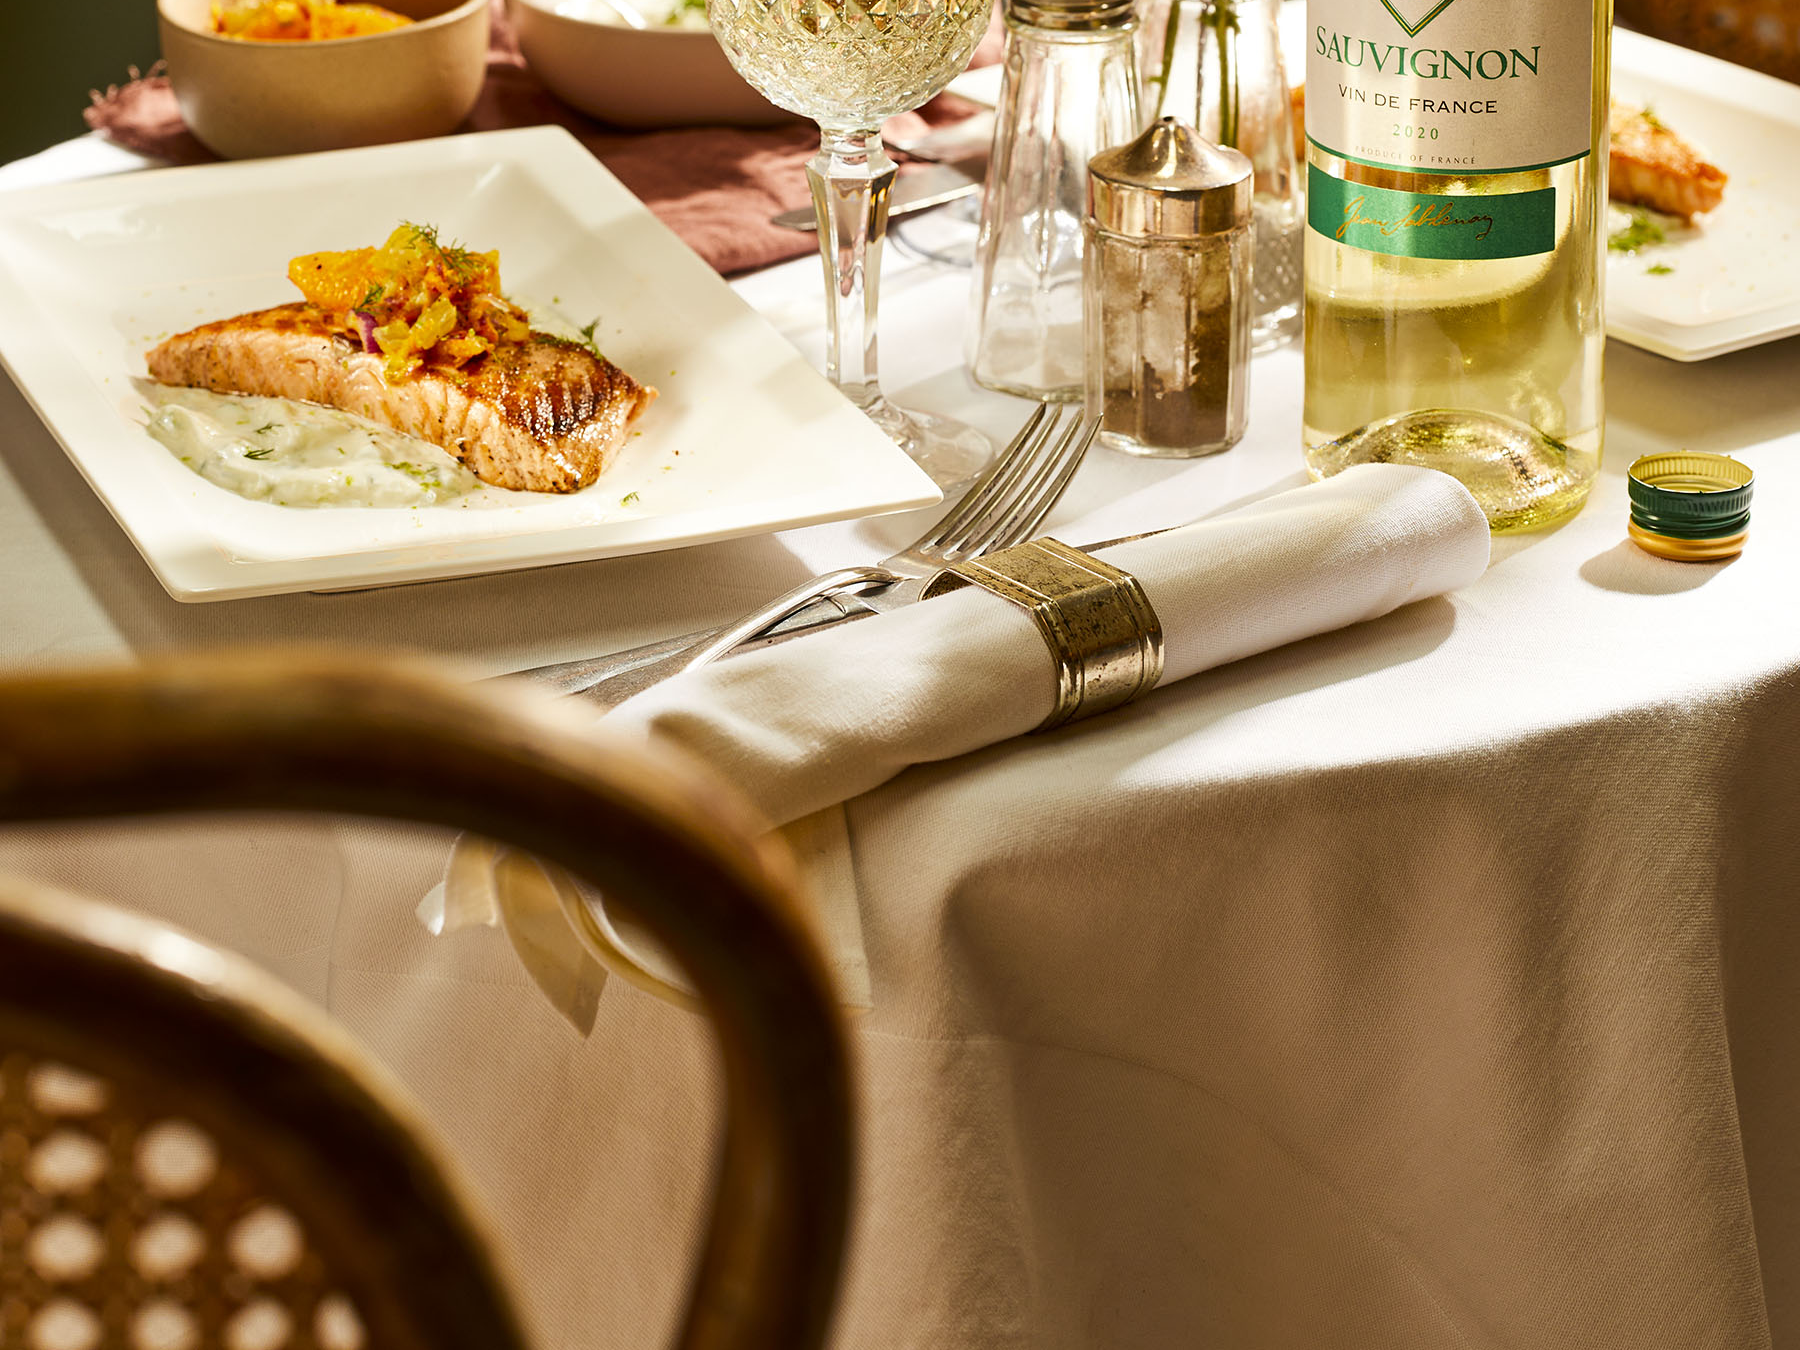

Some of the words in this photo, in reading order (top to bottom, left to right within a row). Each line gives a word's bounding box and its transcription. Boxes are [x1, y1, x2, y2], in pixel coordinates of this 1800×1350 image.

[1316, 25, 1541, 80] SAUVIGNON
[1338, 84, 1367, 103] VIN
[1375, 93, 1400, 109] DE
[1409, 98, 1498, 114] FRANCE
[1393, 124, 1440, 140] 2020
[1355, 145, 1402, 160] PRODUCE
[1410, 154, 1424, 162] OF
